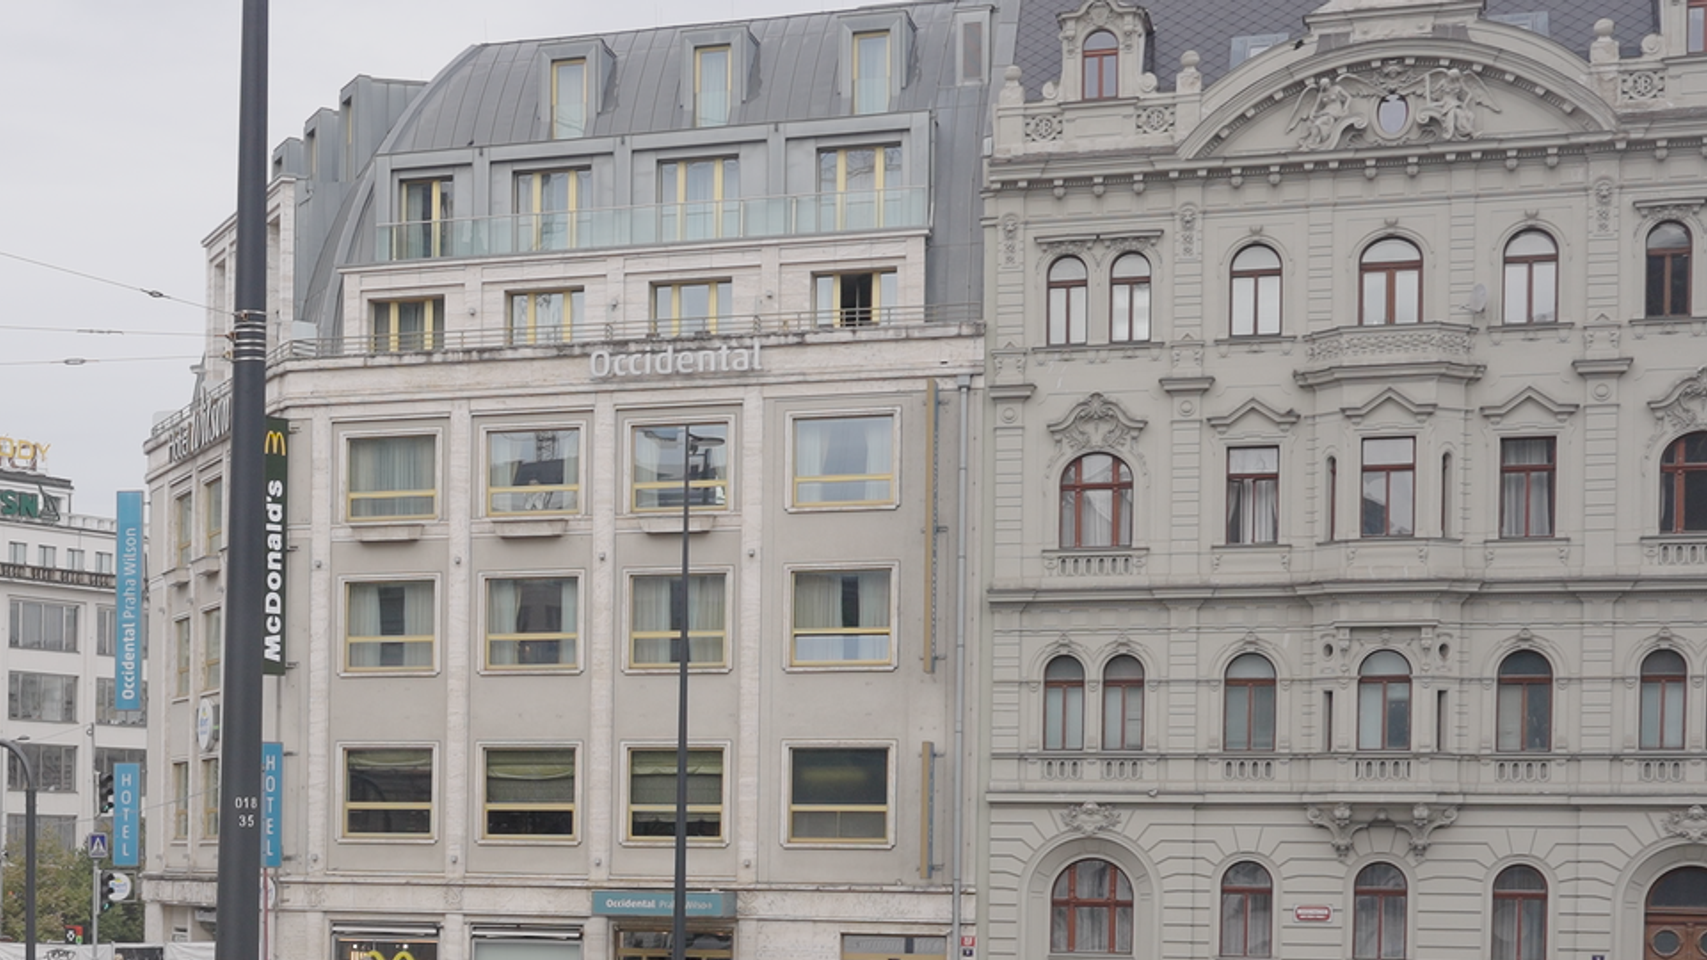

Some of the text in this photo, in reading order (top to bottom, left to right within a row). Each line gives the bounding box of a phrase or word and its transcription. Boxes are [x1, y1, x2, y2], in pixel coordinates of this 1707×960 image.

[590, 338, 762, 377] Occidental
[264, 479, 283, 662] McDonald's
[122, 527, 137, 700] Occidental Praha Wilson
[121, 773, 132, 857] HOTEL
[235, 797, 257, 809] 018
[238, 815, 254, 828] 35
[264, 755, 276, 857] HOTEL
[605, 899, 656, 908] Occidental
